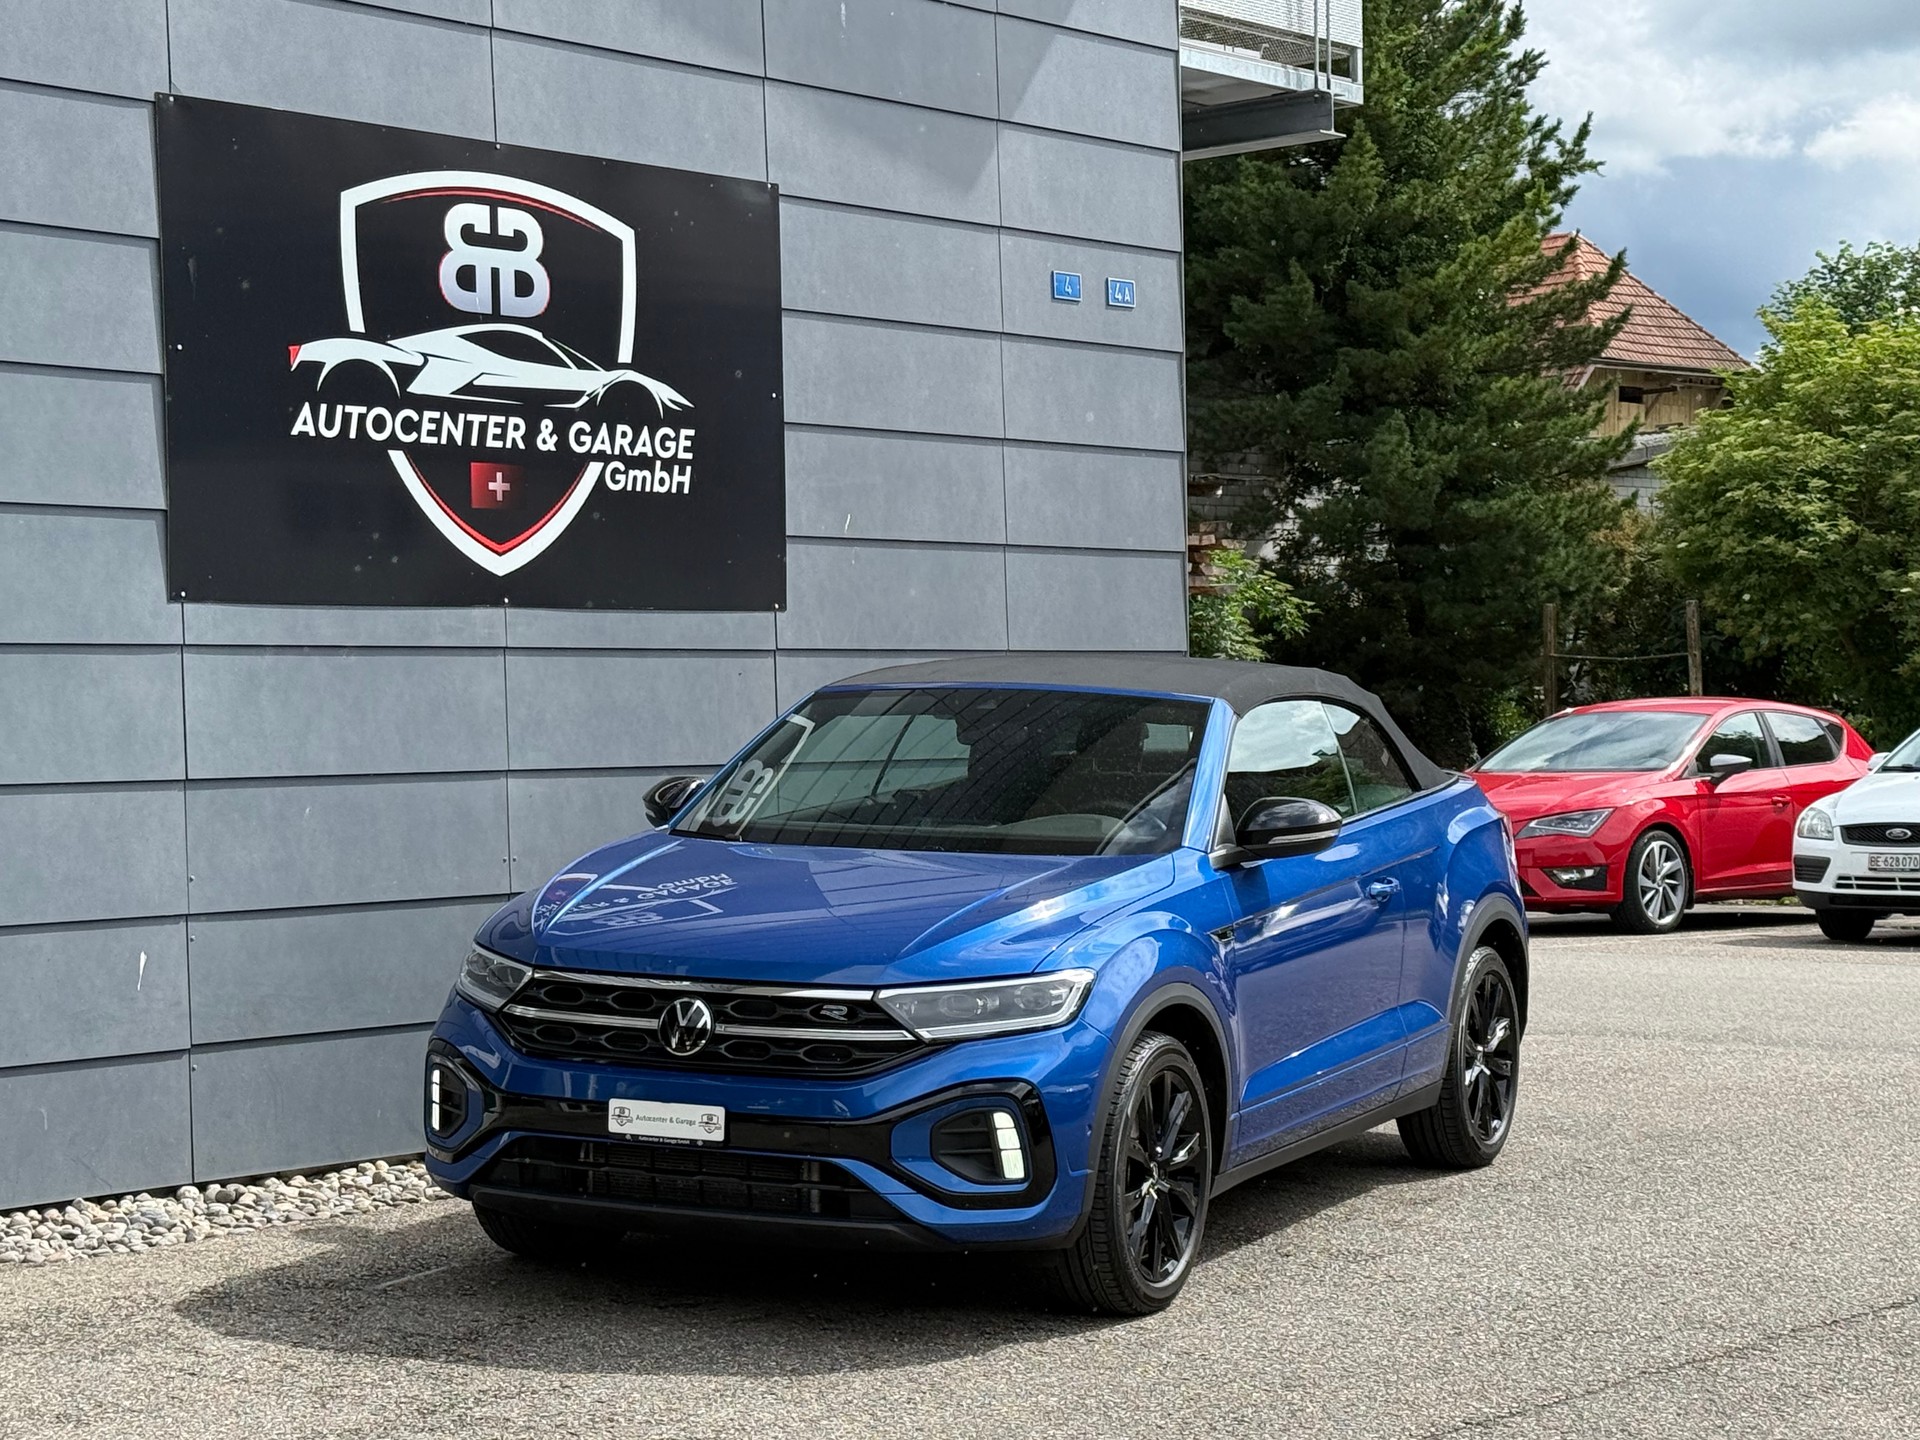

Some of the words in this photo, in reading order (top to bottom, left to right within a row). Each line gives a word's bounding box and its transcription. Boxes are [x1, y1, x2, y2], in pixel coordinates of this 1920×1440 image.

[1064, 276, 1073, 295] 4
[1114, 283, 1131, 302] 4A
[290, 401, 527, 450] AUTOCENTER
[536, 418, 559, 452] &
[568, 420, 696, 460] GARAGE
[604, 459, 692, 495] GmbH
[635, 1114, 668, 1123] Autocenter
[675, 1117, 696, 1127] Garage
